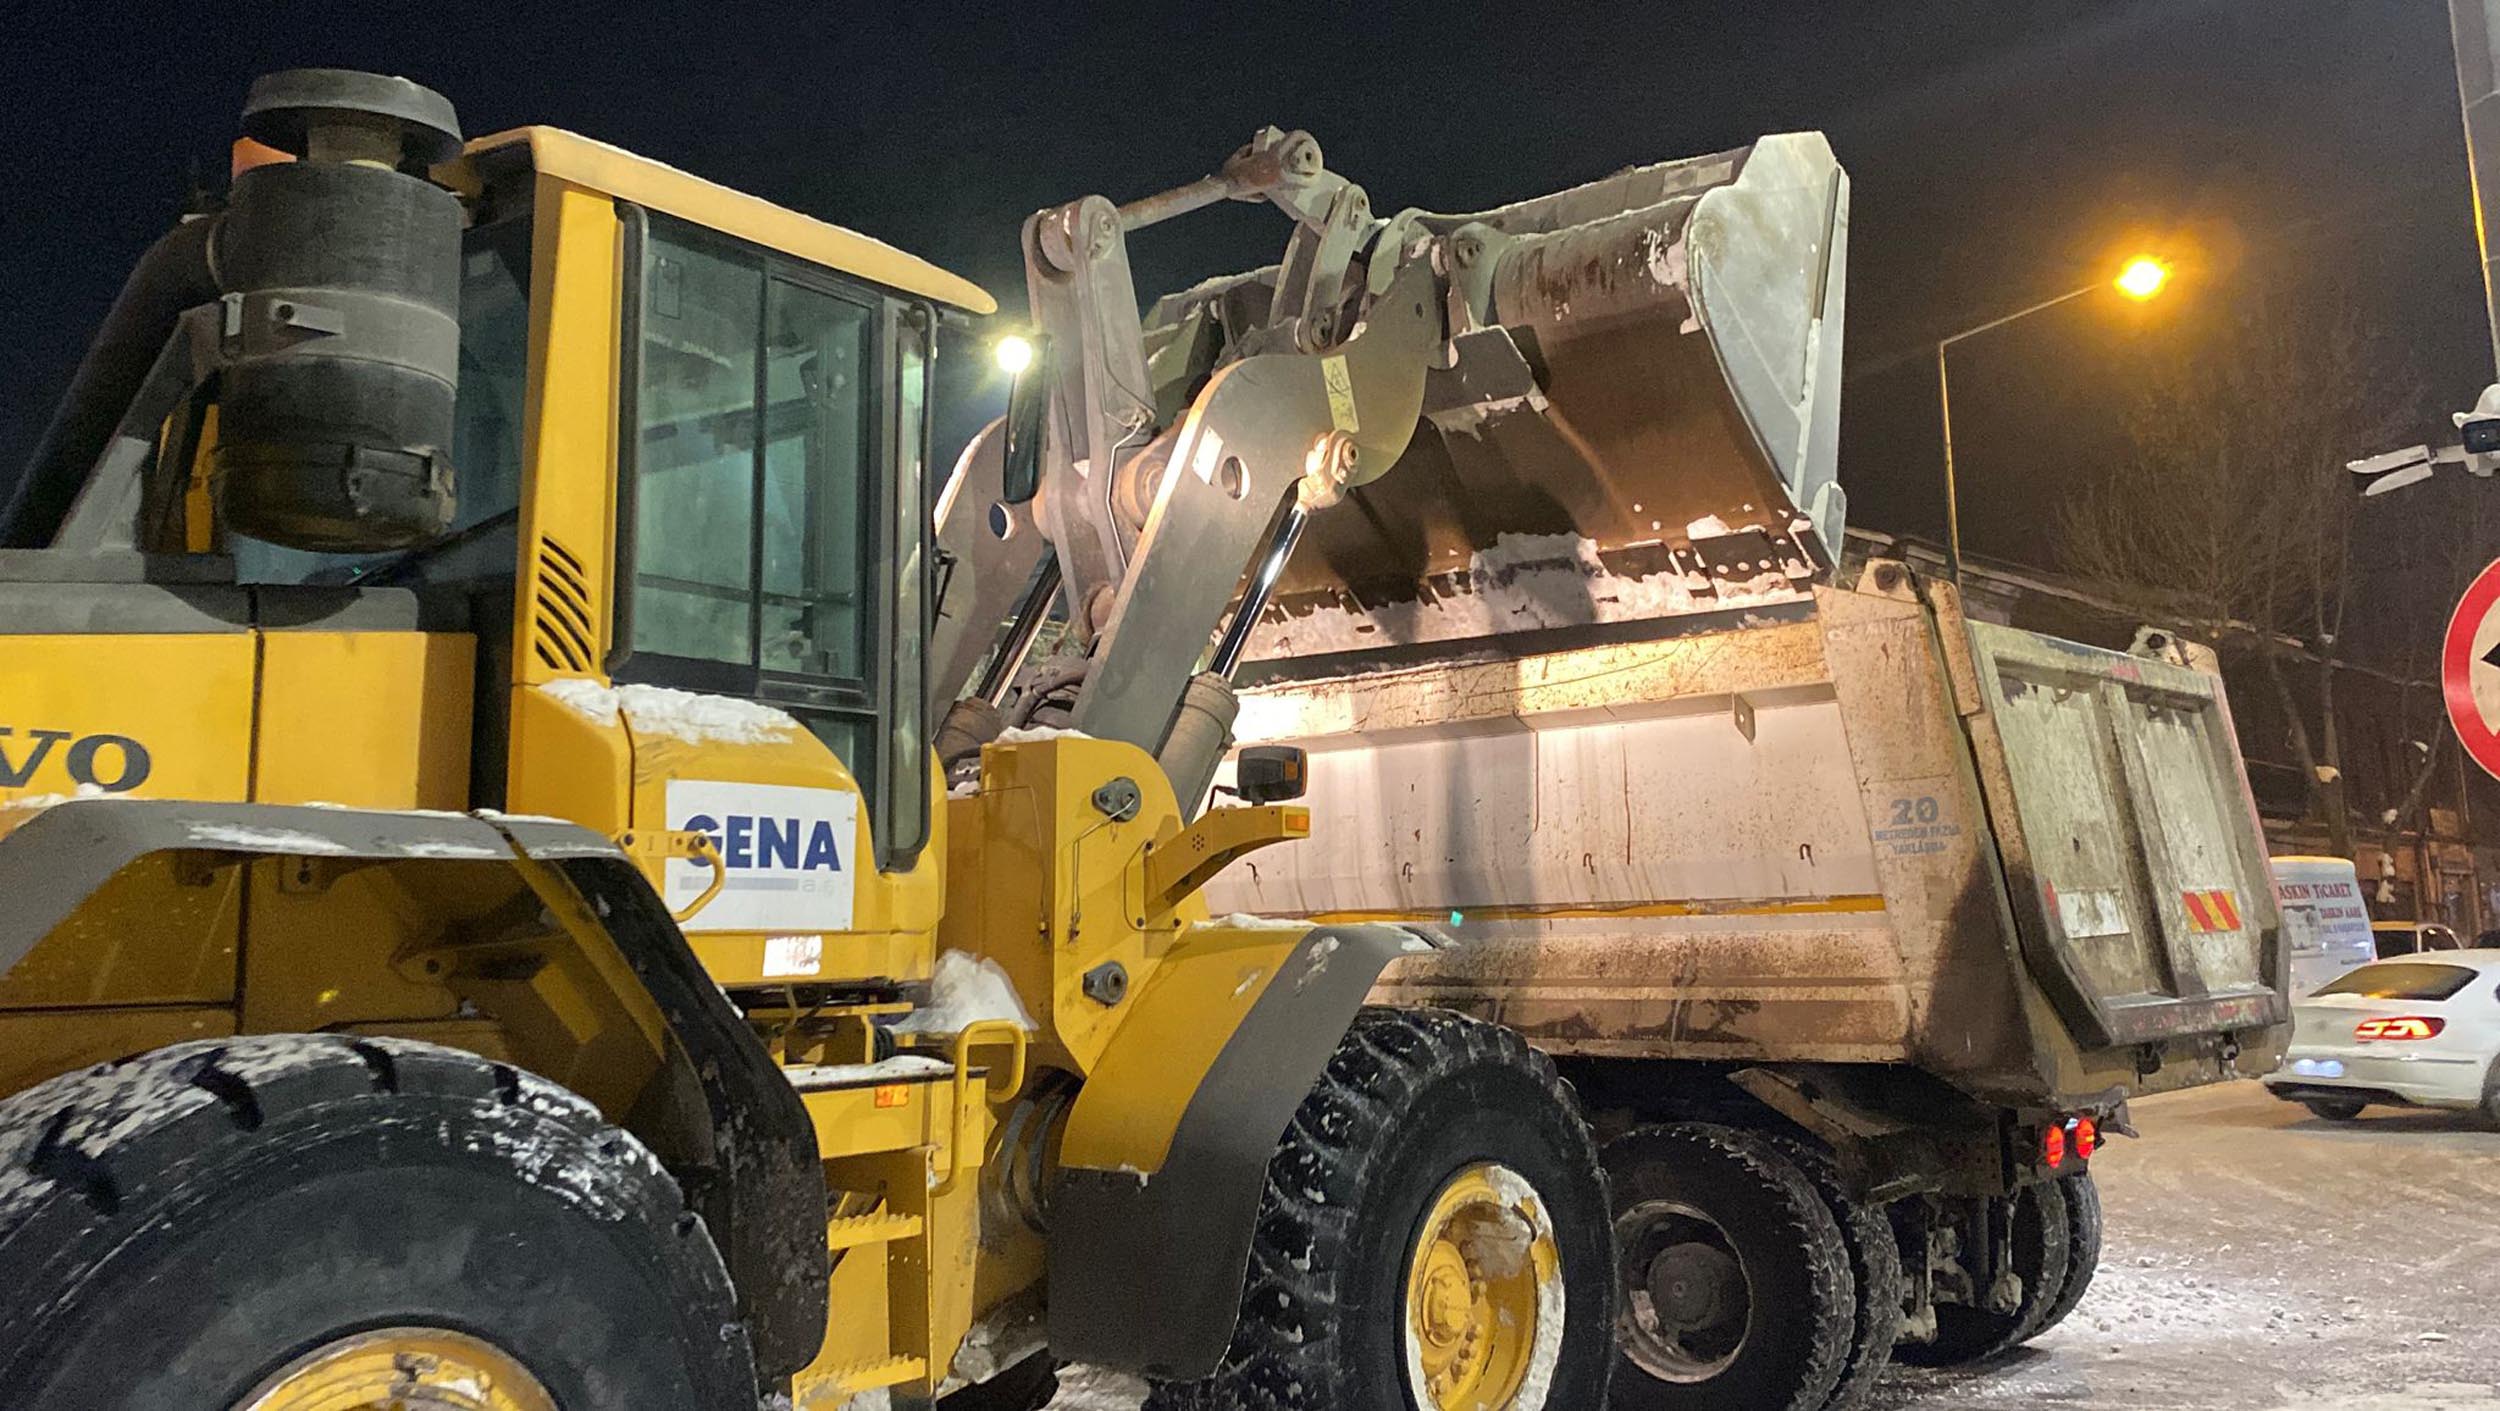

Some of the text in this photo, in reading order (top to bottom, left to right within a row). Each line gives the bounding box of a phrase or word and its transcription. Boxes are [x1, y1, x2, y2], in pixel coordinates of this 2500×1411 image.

[0, 727, 150, 792] VO
[1891, 797, 1939, 825] 20
[684, 814, 841, 871] GENA
[2278, 885, 2311, 899] ASKIN
